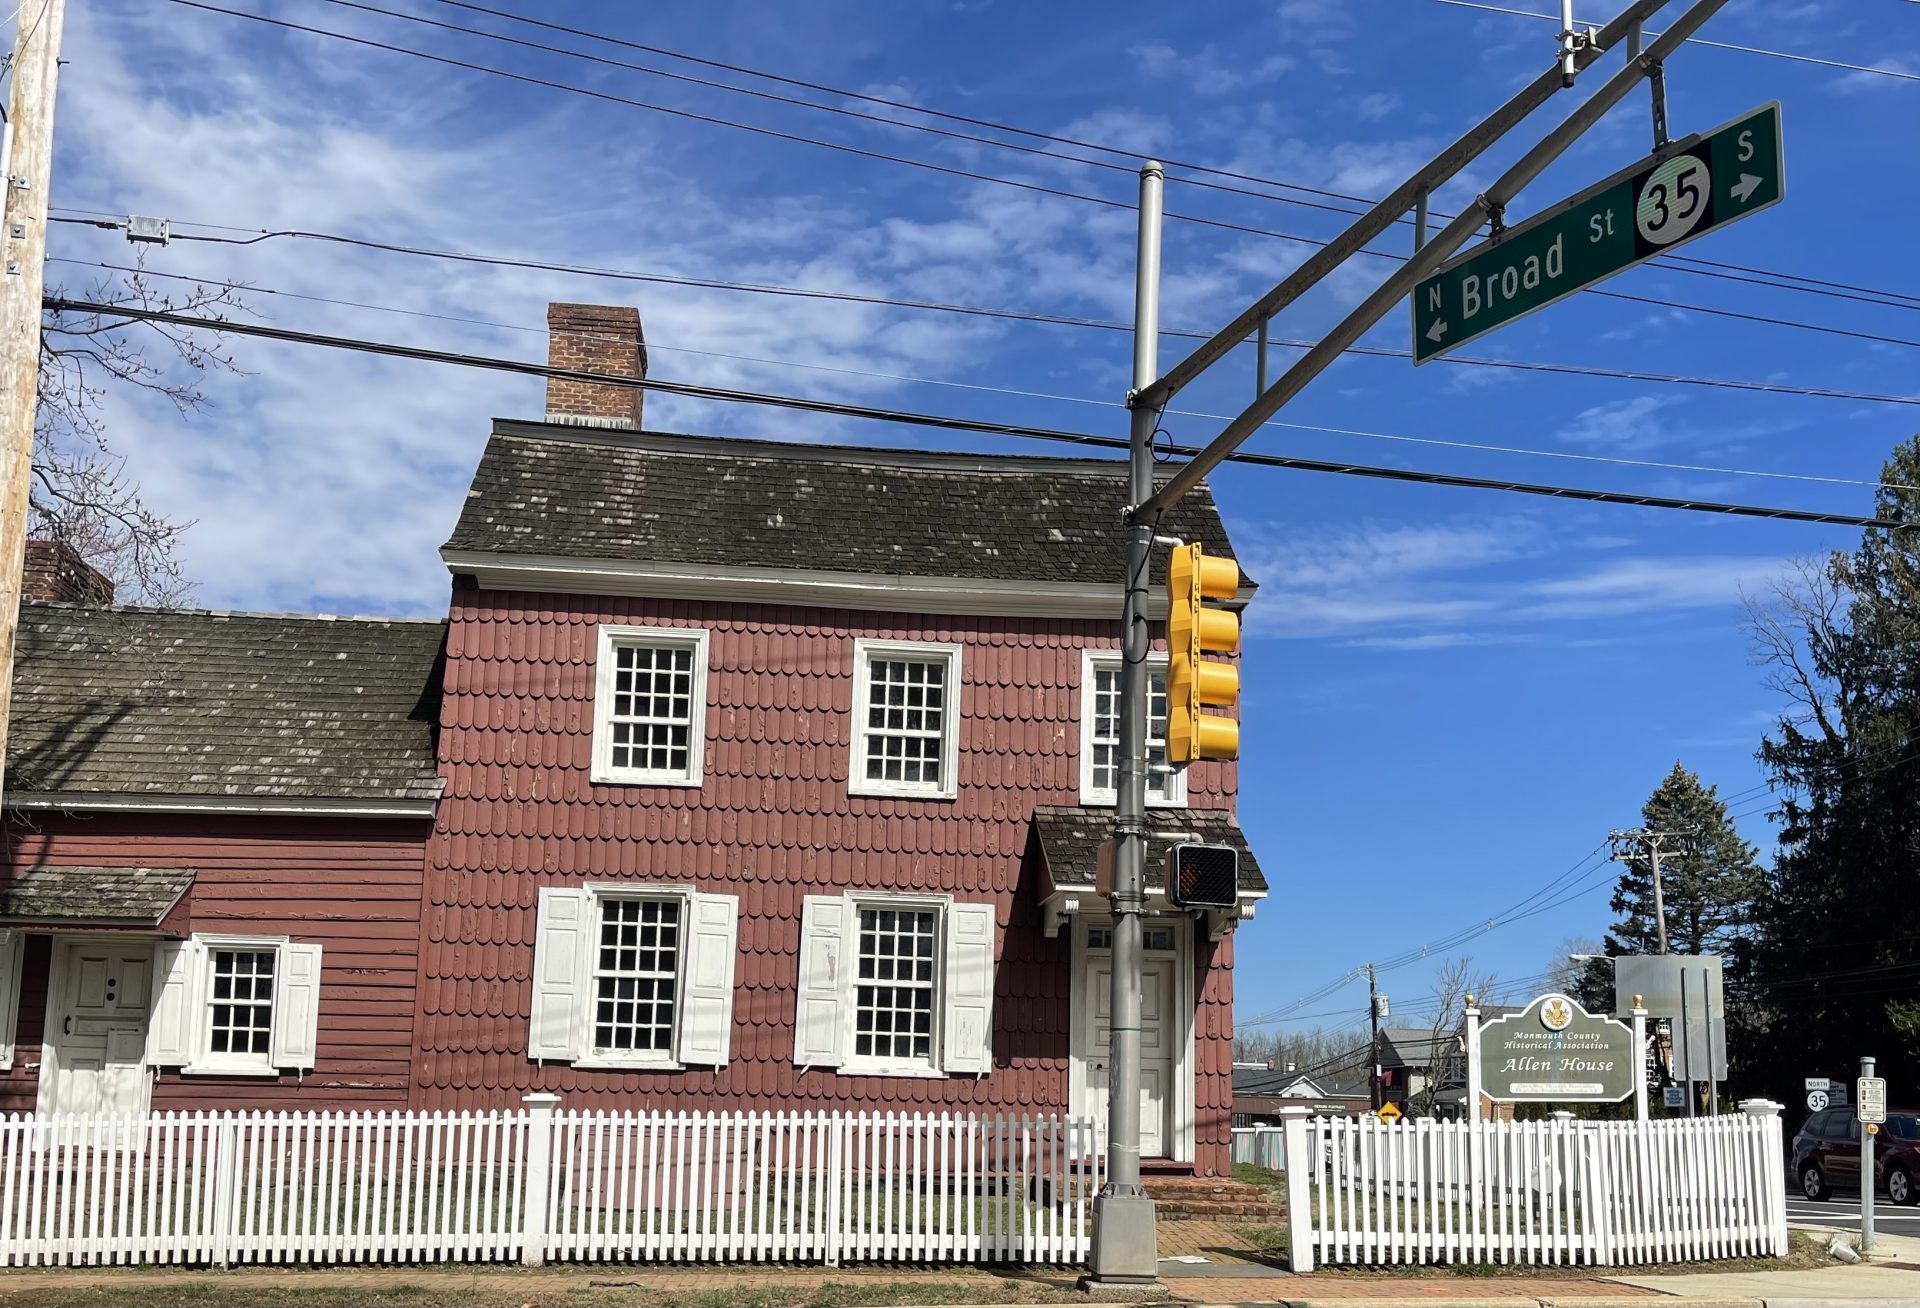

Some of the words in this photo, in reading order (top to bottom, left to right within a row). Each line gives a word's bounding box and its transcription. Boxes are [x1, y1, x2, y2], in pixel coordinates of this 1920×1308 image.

[1737, 129, 1754, 162] S
[1646, 166, 1700, 232] 35
[1462, 232, 1563, 319] Broad
[1589, 208, 1615, 243] St
[1429, 282, 1442, 312] N
[1504, 1041, 1551, 1049] Historical
[1554, 1041, 1609, 1050] Association
[1513, 1031, 1563, 1040] Monmouth
[1567, 1032, 1601, 1041] County
[1500, 1056, 1551, 1073] Allen
[1559, 1057, 1614, 1071] House
[1811, 1095, 1826, 1108] 35
